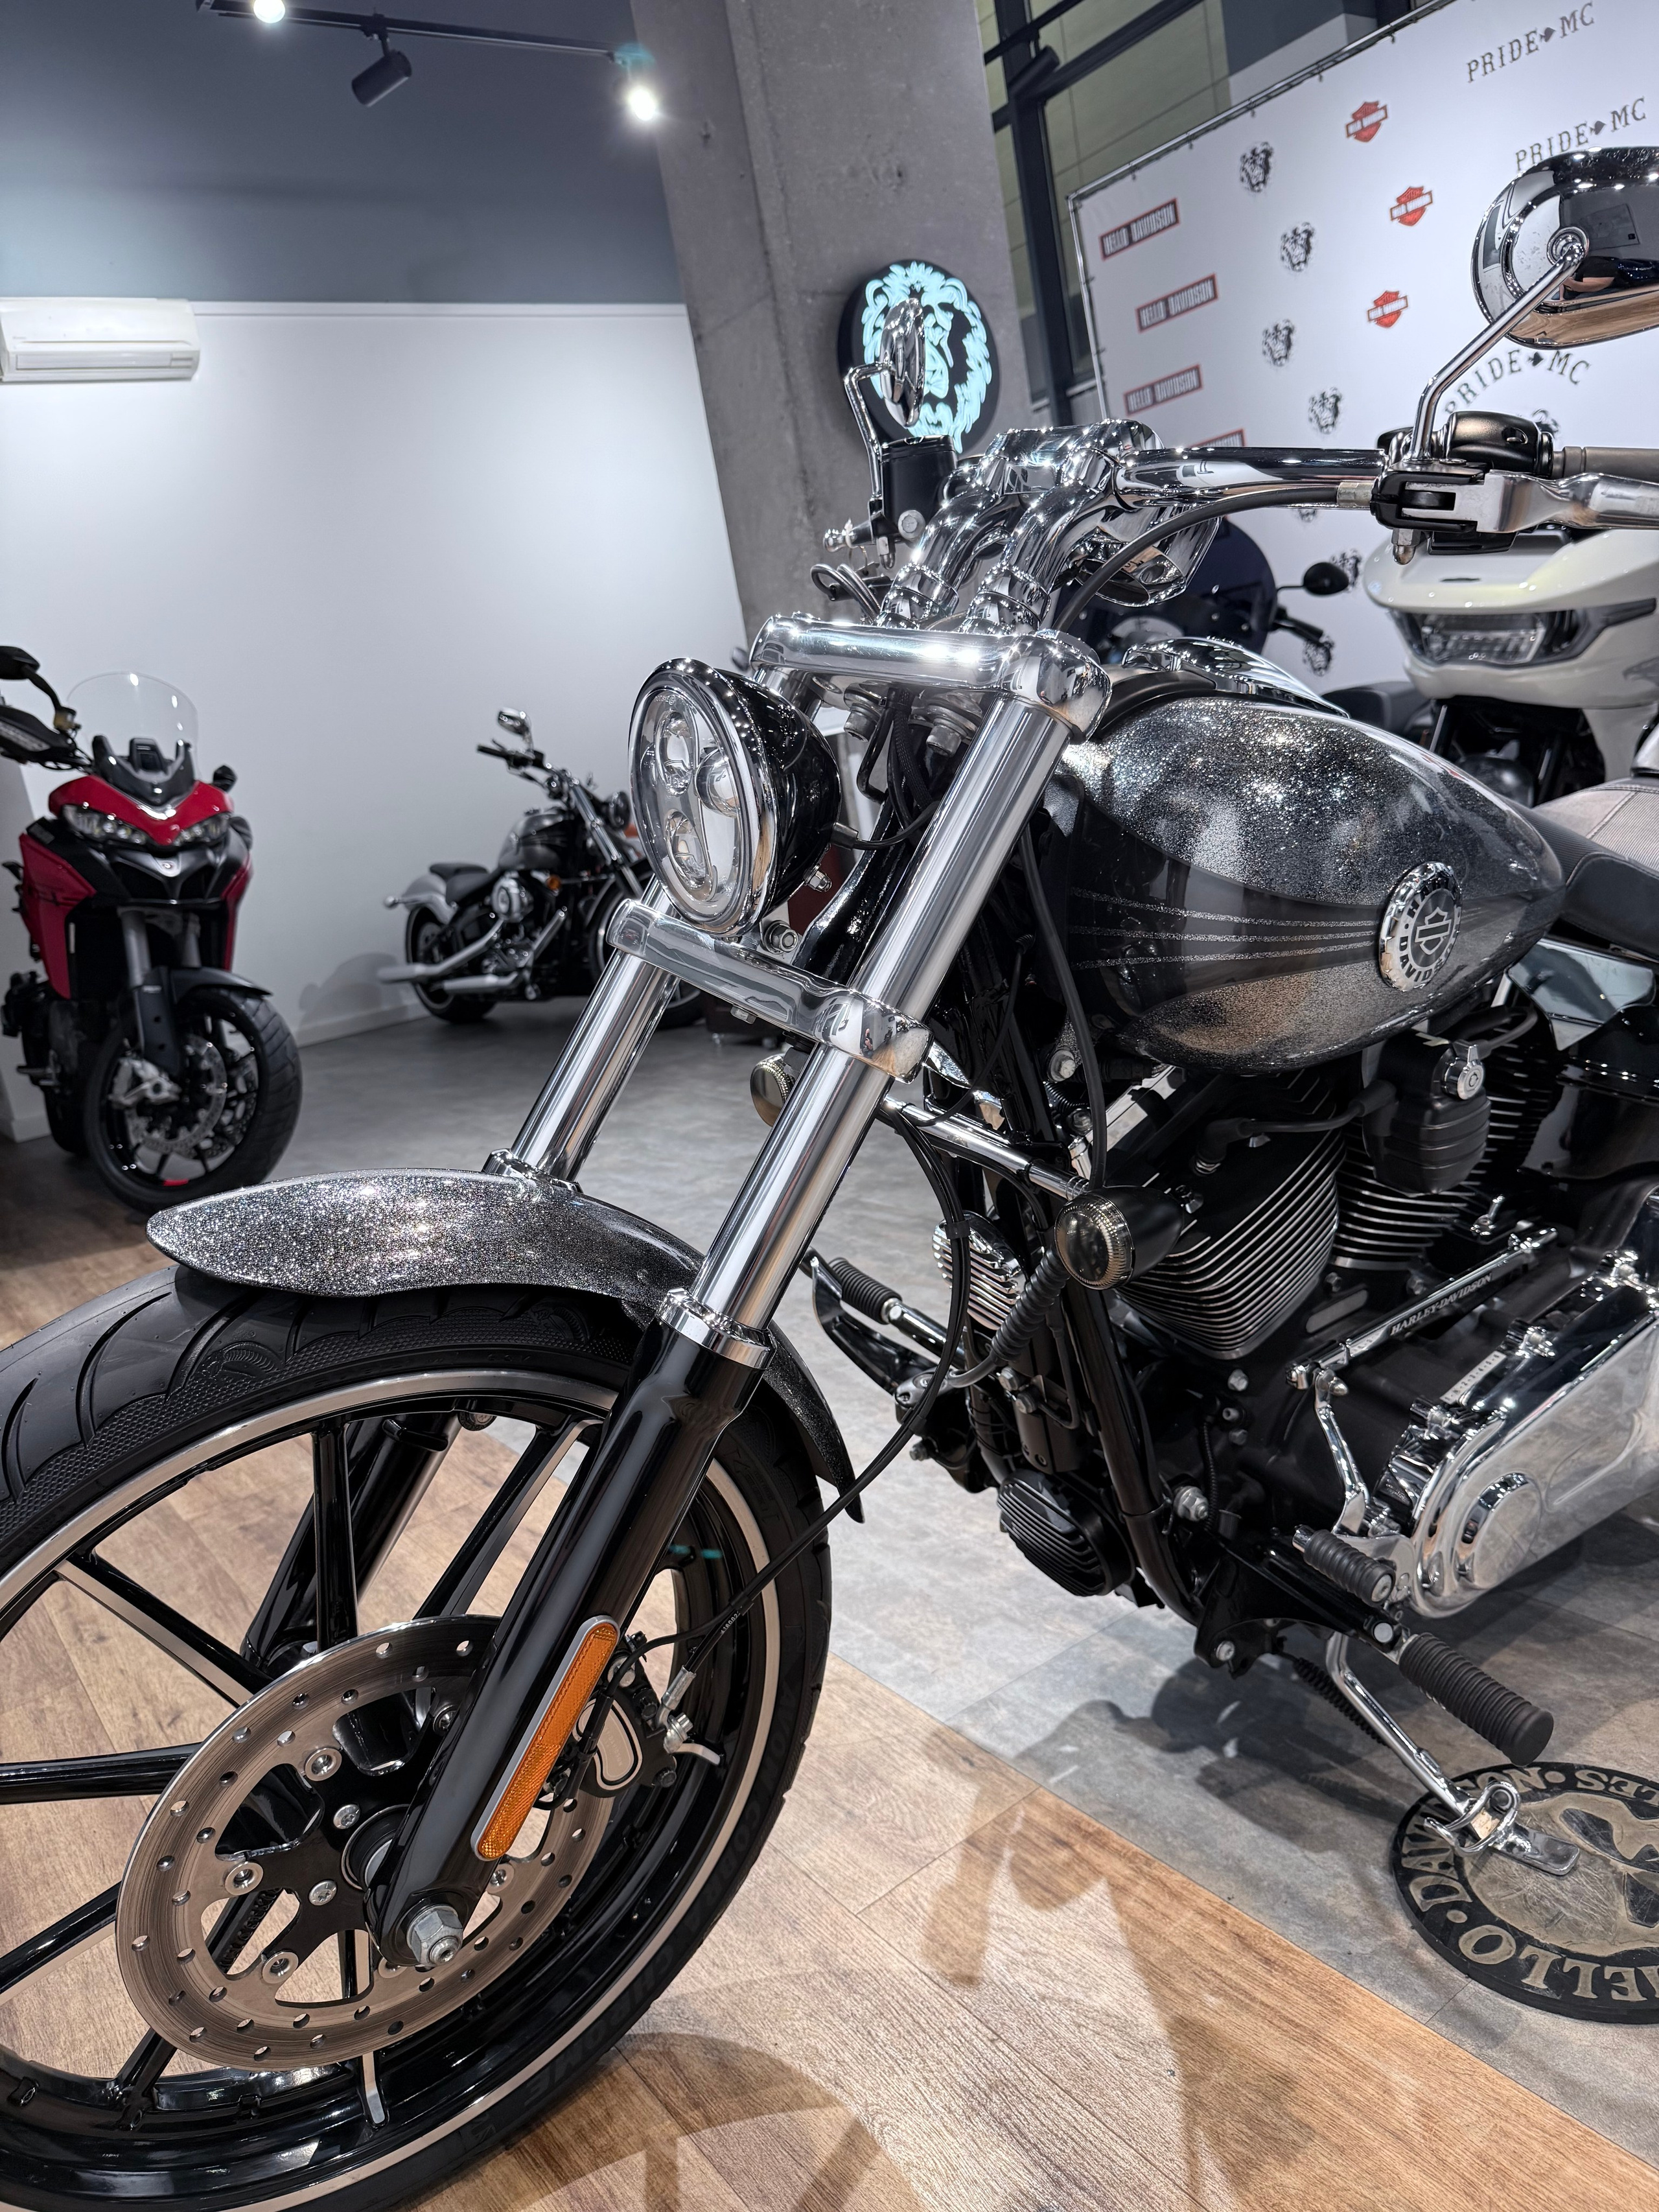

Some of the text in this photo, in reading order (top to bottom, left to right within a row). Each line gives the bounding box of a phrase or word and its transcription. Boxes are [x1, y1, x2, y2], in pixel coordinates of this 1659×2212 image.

[1467, 3, 1594, 83] PRIDE MC
[1515, 97, 1646, 172] PRIDE MC
[1130, 202, 1177, 242] DAVIDSON
[1547, 351, 1591, 385] MC
[1390, 1273, 1492, 1336] HARLEY-DAVIDSON
